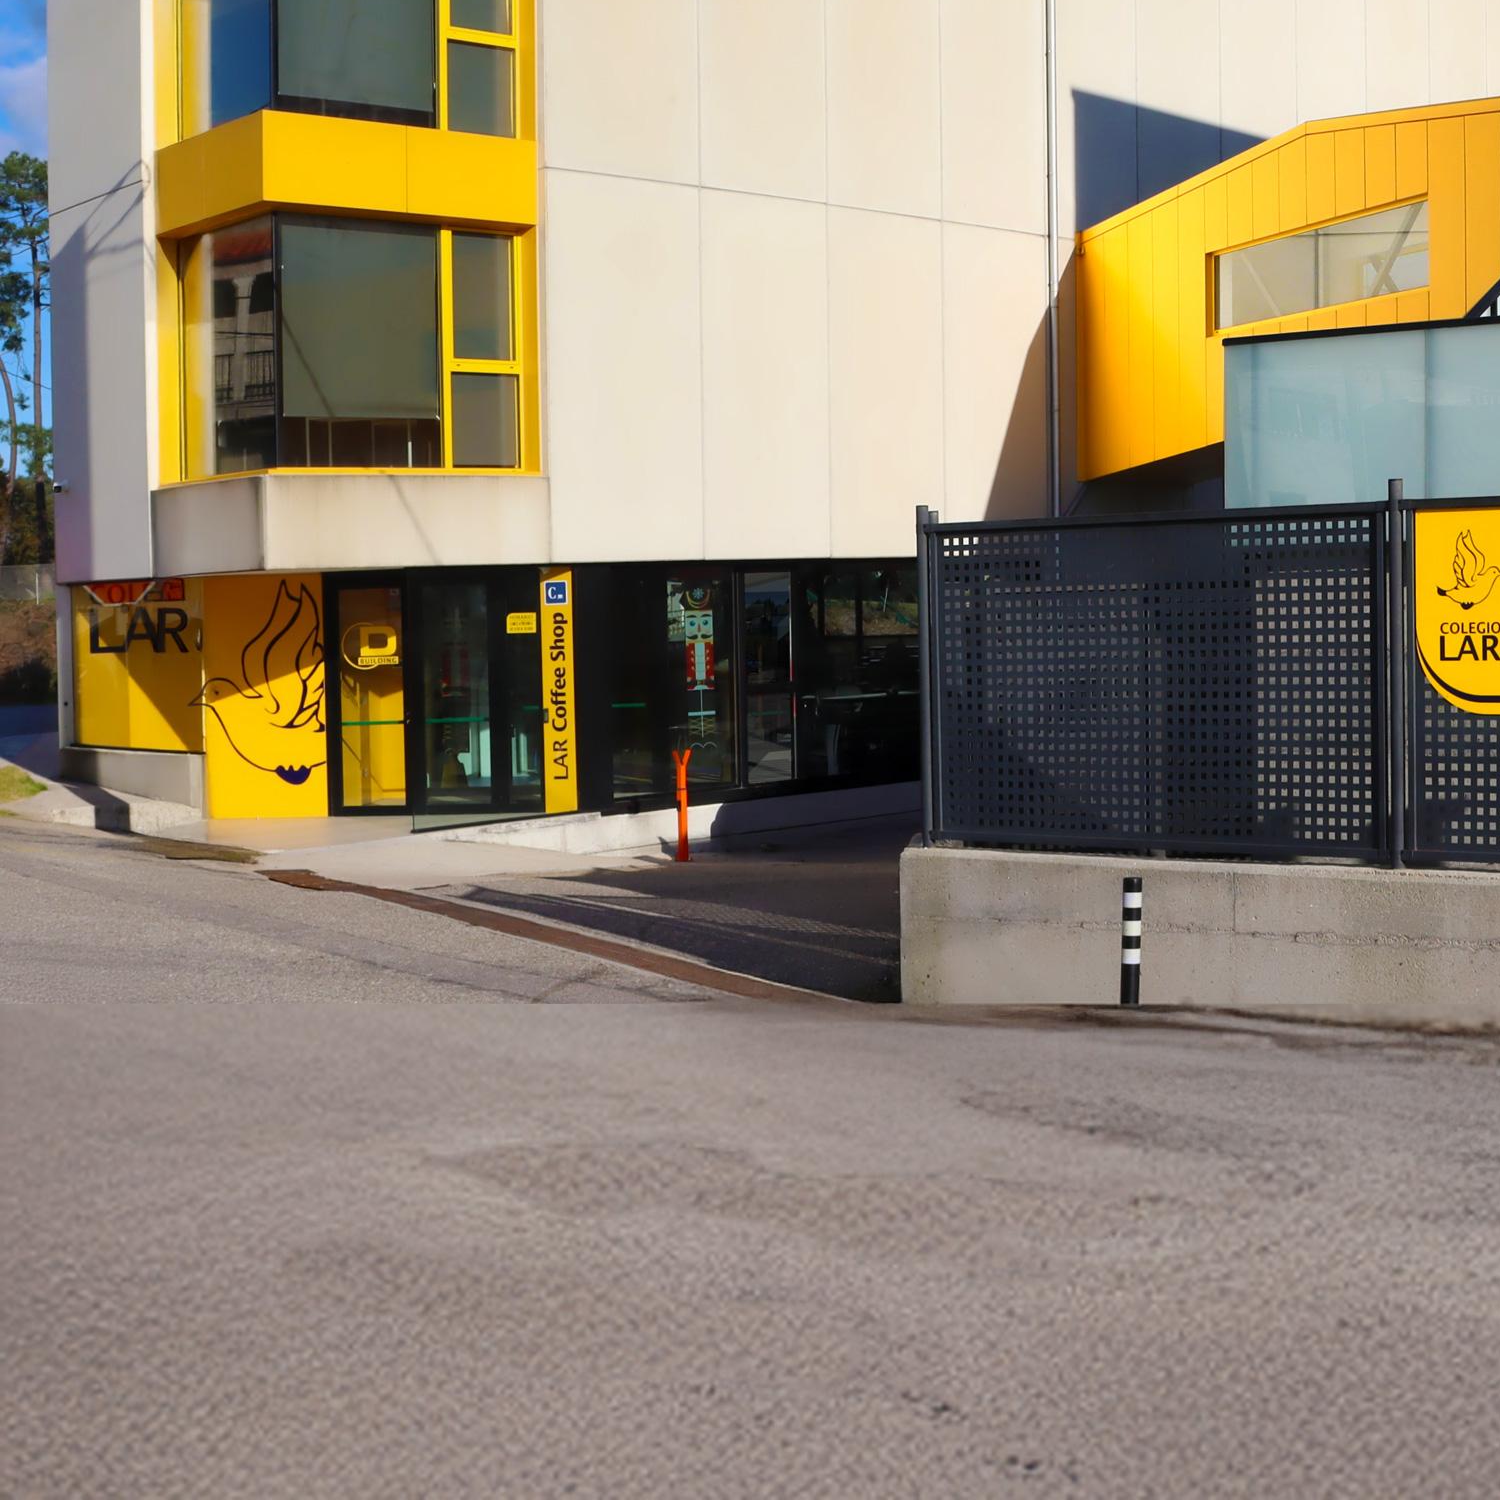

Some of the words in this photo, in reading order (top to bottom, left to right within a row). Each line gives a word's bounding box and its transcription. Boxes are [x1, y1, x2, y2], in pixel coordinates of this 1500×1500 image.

[87, 605, 190, 654] LAR
[549, 611, 568, 662] Shop
[359, 656, 397, 665] BUILDING
[550, 667, 568, 732] Coffee
[553, 739, 569, 781] LAR
